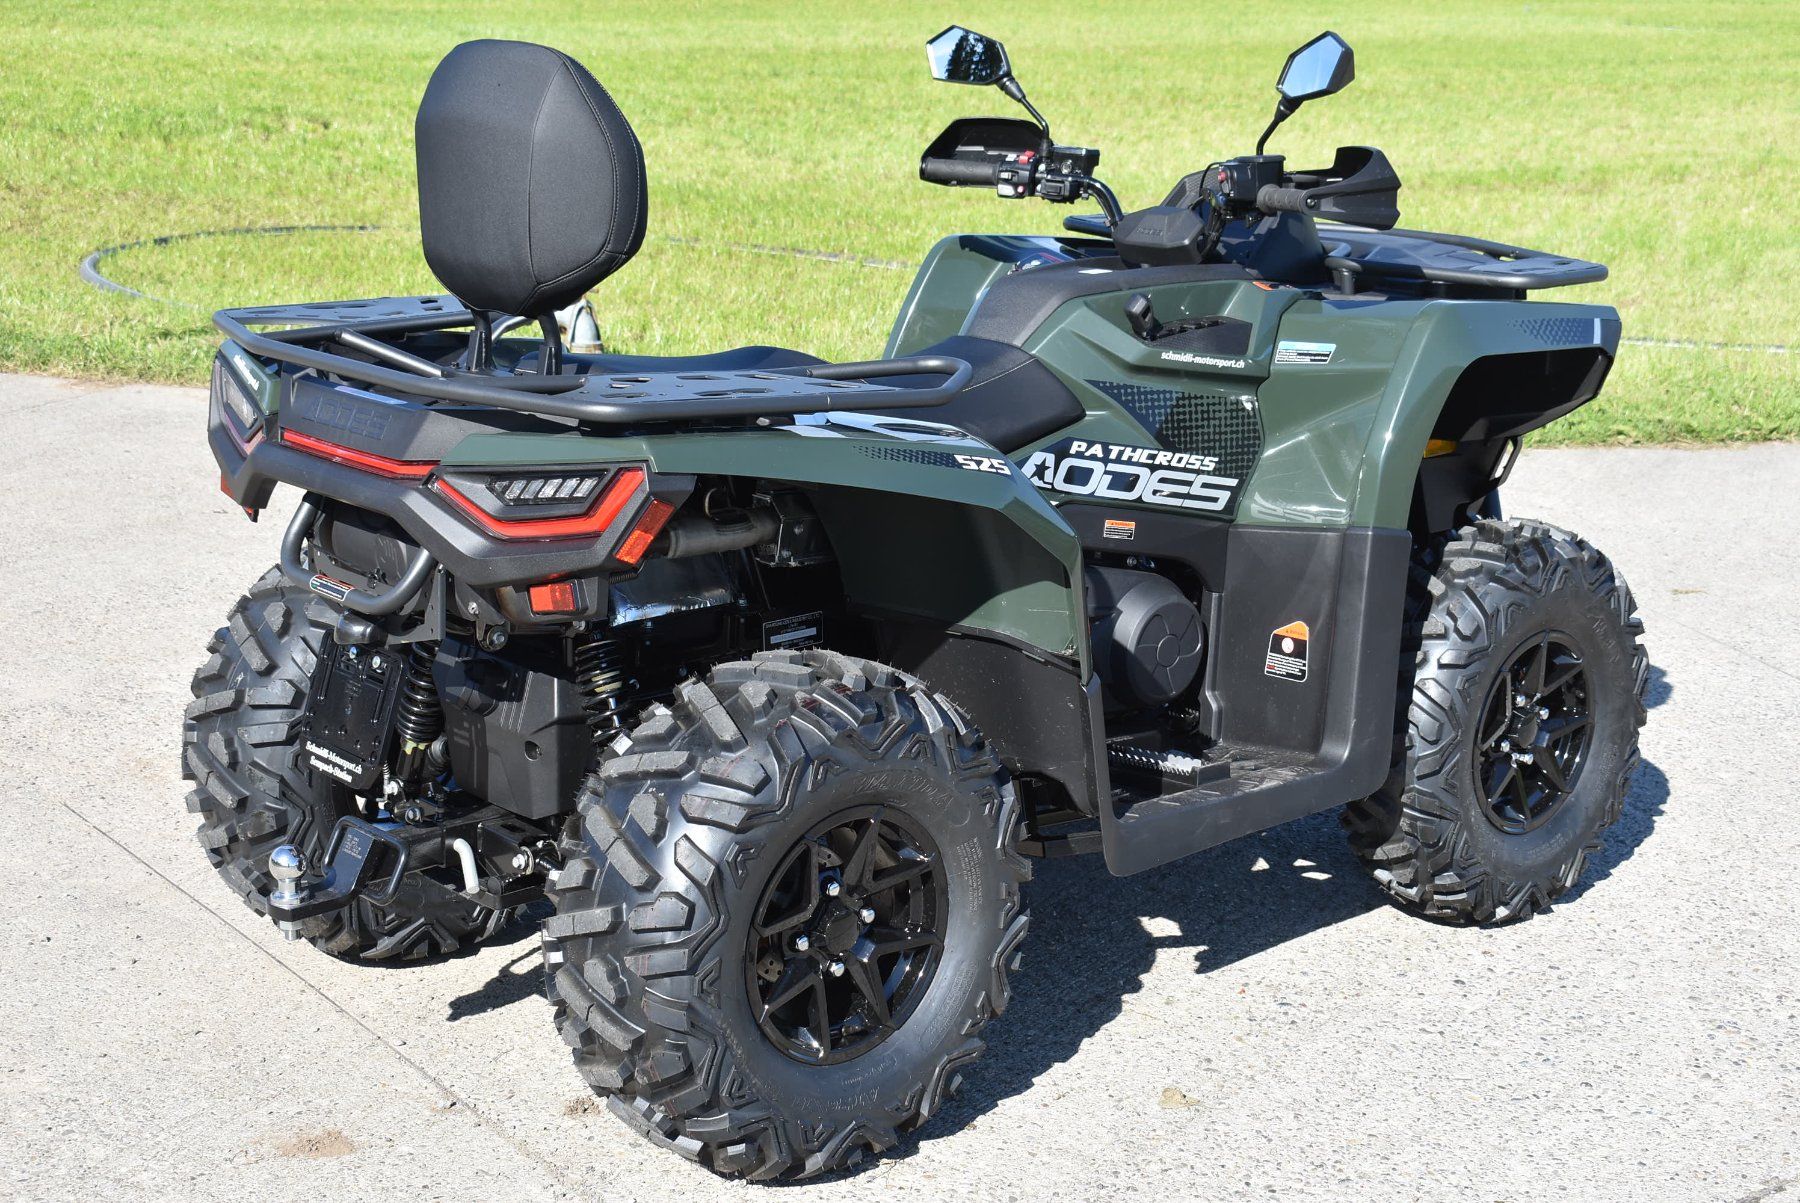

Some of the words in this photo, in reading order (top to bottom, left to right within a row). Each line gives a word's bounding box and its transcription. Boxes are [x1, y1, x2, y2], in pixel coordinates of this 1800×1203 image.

[953, 454, 1012, 476] 525
[1069, 440, 1219, 471] PATHCROSS
[1021, 451, 1239, 511] AODES
